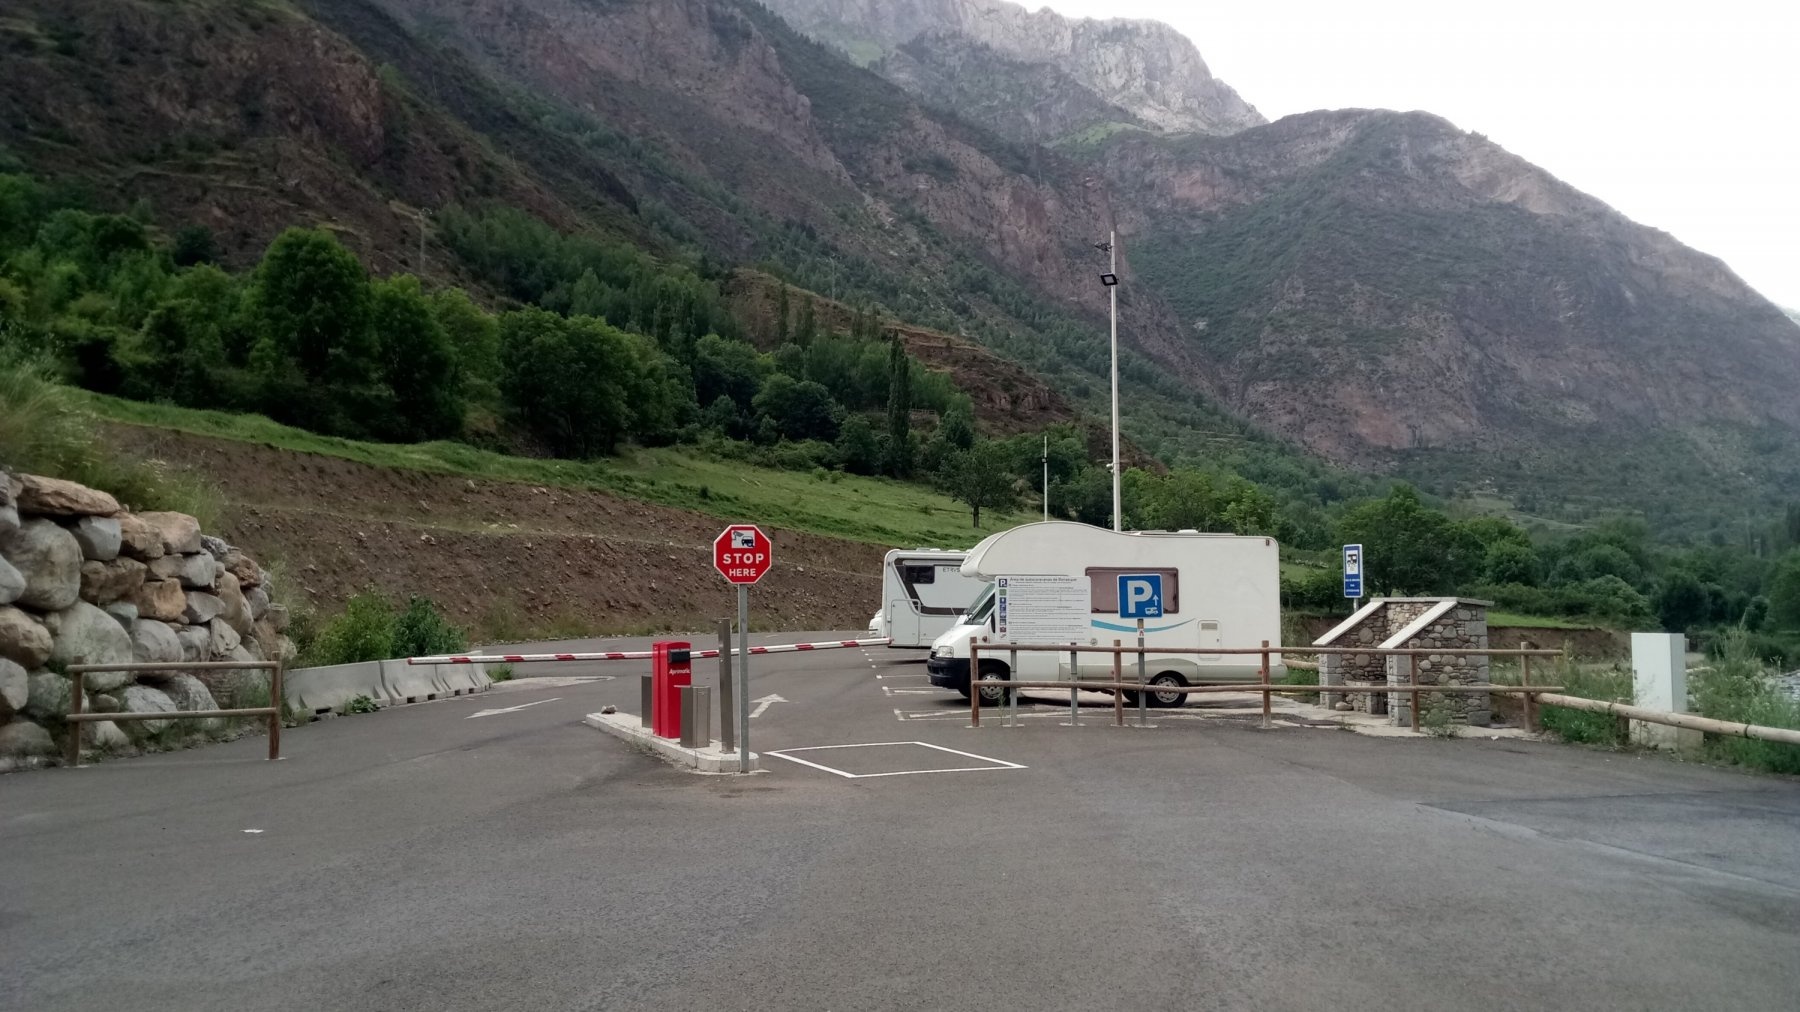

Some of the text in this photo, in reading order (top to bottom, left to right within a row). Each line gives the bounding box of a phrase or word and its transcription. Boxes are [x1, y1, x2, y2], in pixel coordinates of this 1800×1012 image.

[722, 553, 764, 564] STOP
[728, 568, 757, 577] HERE
[1127, 580, 1153, 614] P
